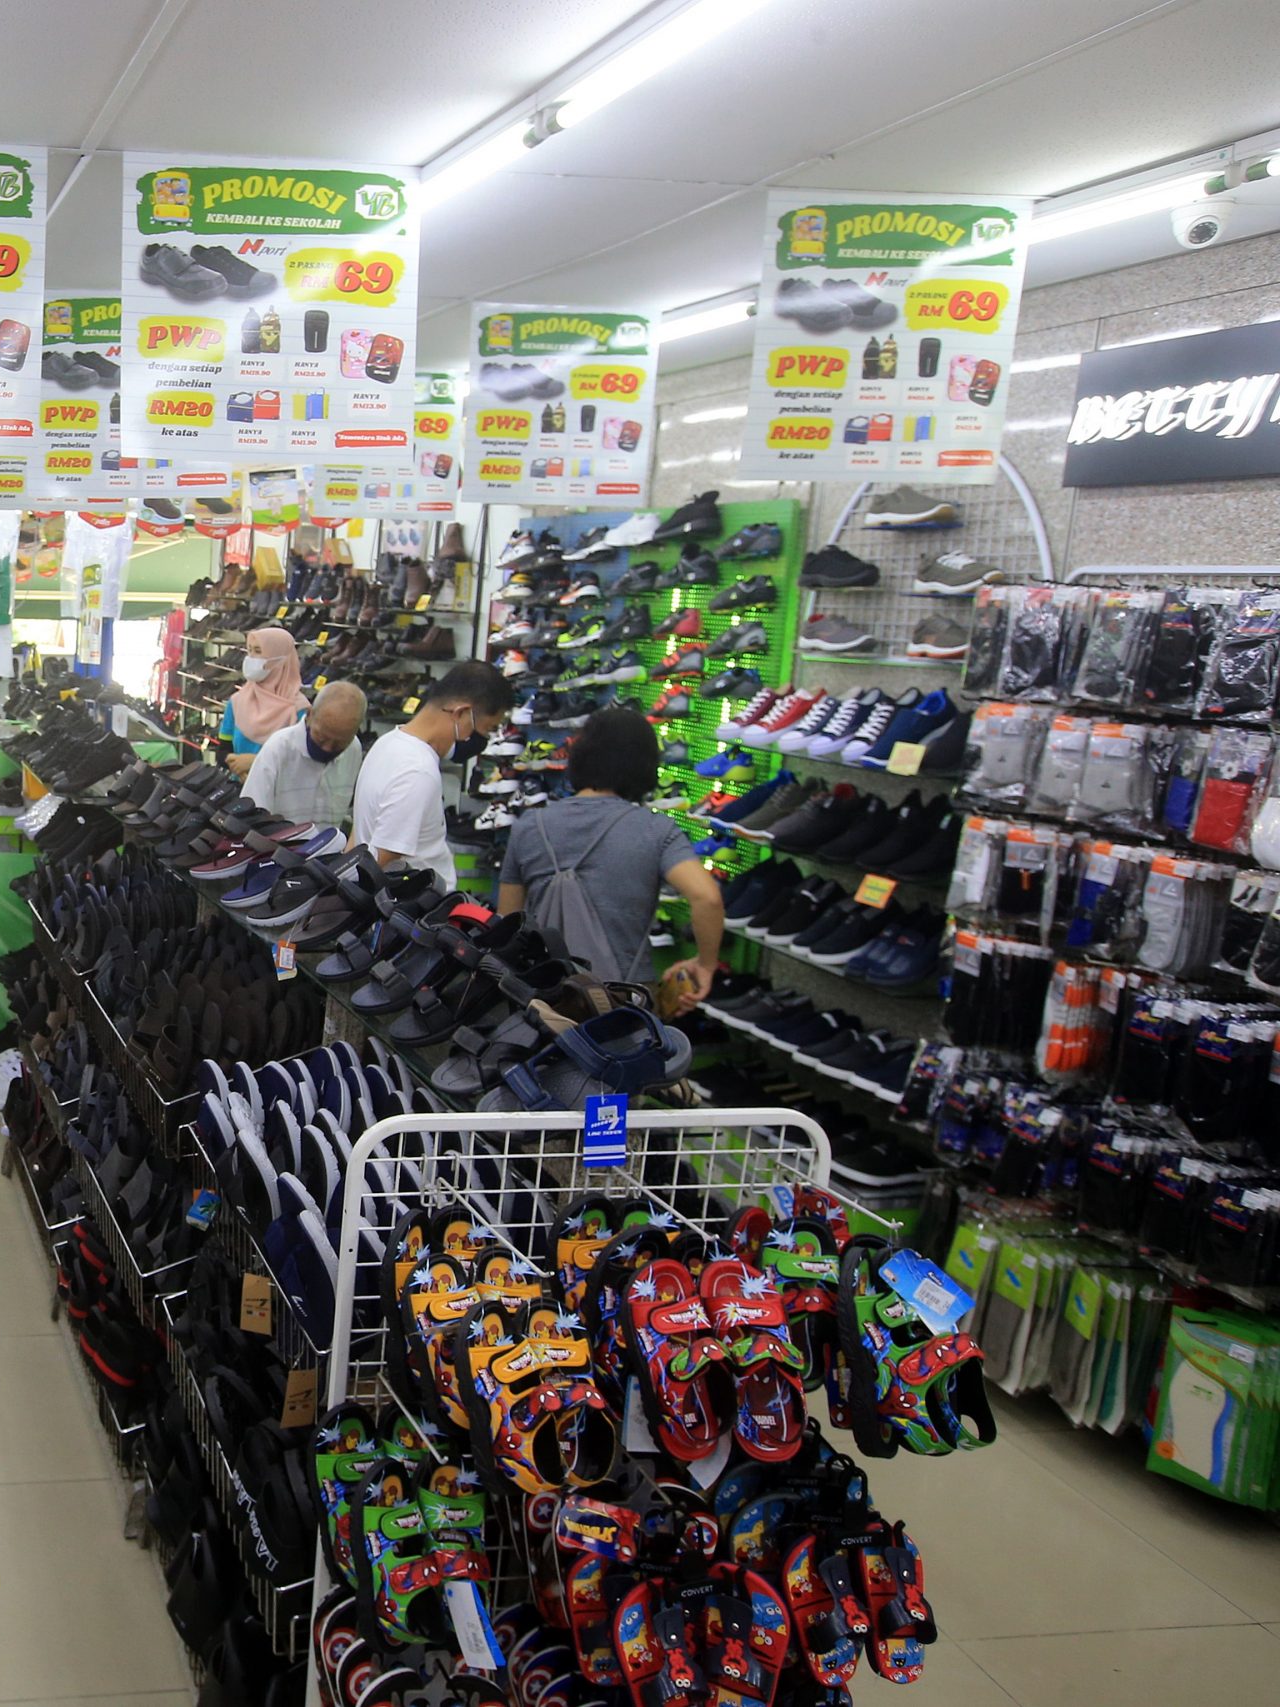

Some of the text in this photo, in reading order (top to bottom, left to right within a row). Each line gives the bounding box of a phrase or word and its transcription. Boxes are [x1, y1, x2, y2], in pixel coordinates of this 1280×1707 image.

[202, 175, 348, 215] PROMOSI
[205, 212, 342, 229] KEMBALI KE SEKOLAH
[835, 211, 966, 247] PROMOSI
[837, 247, 890, 259] KEMBALI
[300, 261, 393, 294] RM 69
[918, 290, 1000, 321] RM 69
[147, 324, 222, 350] PWP
[520, 317, 613, 342] PROMOSI
[148, 361, 222, 374] dengan setiap
[775, 354, 845, 379] PWP
[155, 377, 212, 389] pembelian
[600, 373, 640, 394] 69
[45, 405, 97, 424] PWP
[149, 399, 213, 418] RM20
[161, 426, 199, 437] ke atas
[419, 418, 449, 434] 69
[481, 415, 529, 431] PWP
[770, 425, 831, 441] RM20
[47, 456, 92, 468] RM20
[841, 1535, 872, 1546] CONVERT
[680, 1585, 714, 1598] CONVERT
